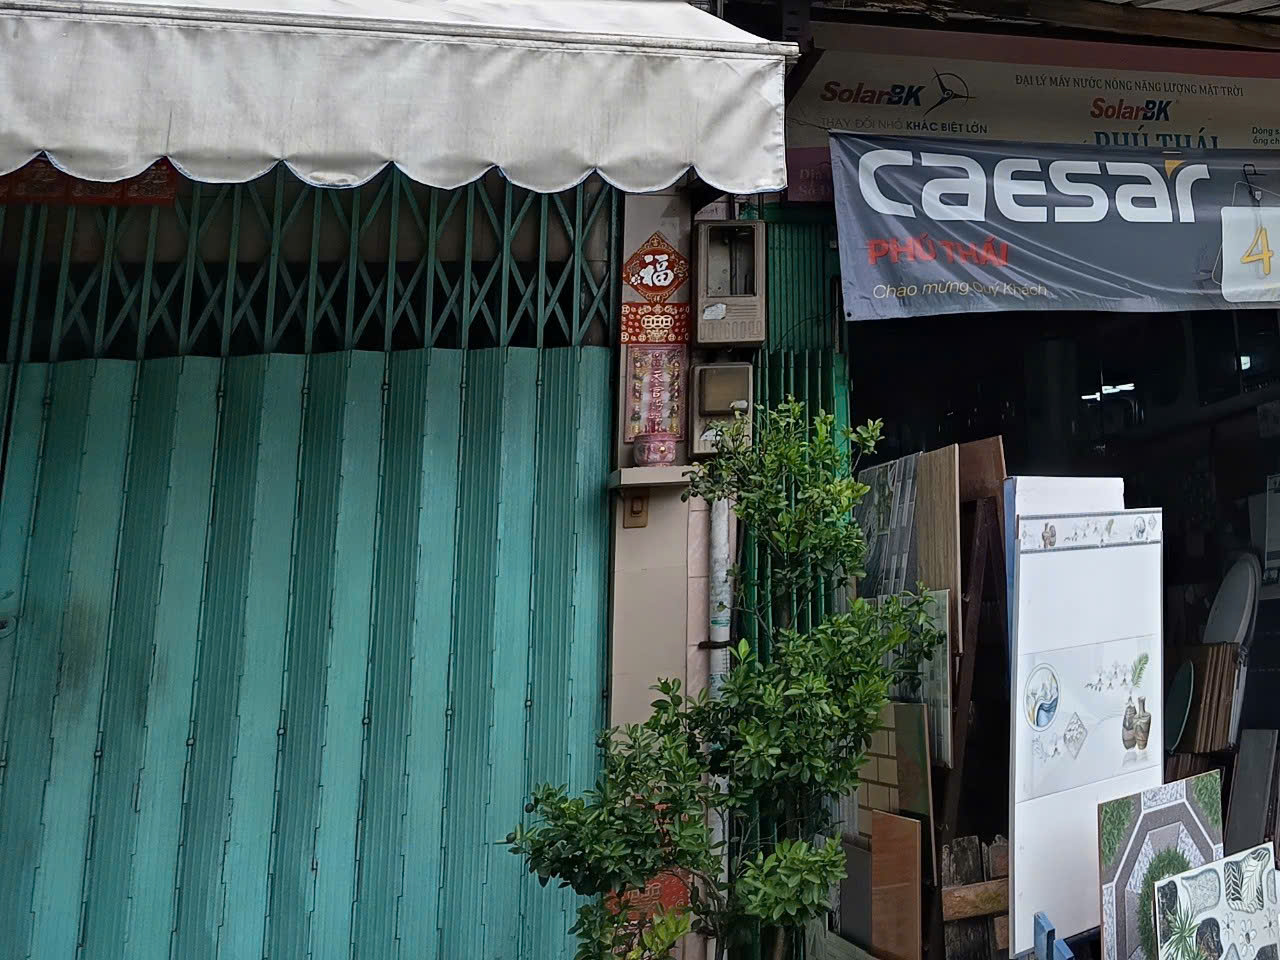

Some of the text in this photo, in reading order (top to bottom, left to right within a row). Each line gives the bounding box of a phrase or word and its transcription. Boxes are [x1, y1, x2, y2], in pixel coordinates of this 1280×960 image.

[1015, 74, 1033, 86] ĐẠI
[1036, 73, 1047, 86] LÝ
[1049, 75, 1070, 88] MÁY
[820, 81, 926, 107] SolarBK
[1090, 97, 1172, 121] SolarBK
[906, 119, 938, 132] KHÁC
[941, 120, 963, 133] BIỆT
[639, 254, 675, 287] 福
[873, 281, 917, 299] Chào
[921, 279, 969, 296] mừng
